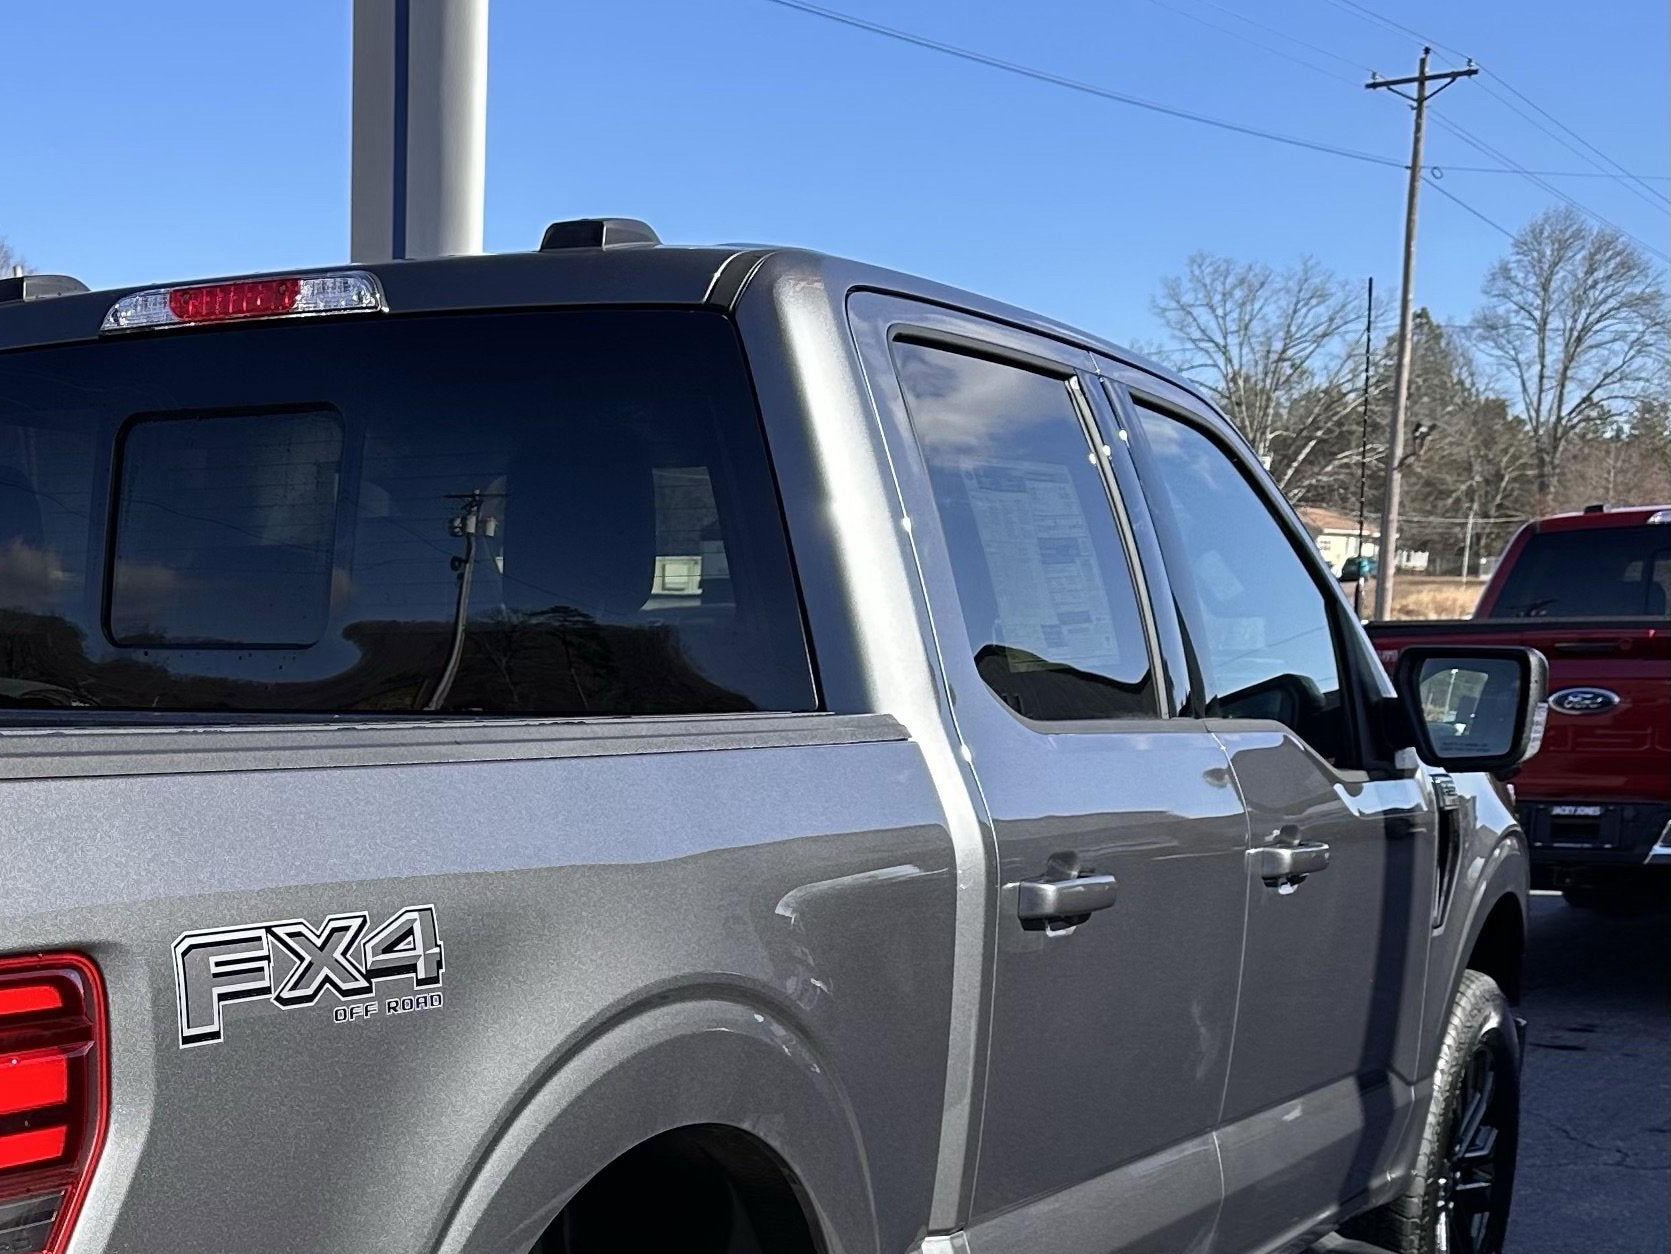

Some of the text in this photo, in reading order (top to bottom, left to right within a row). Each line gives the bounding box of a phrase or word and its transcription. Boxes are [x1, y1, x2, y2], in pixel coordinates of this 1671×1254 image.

[171, 904, 445, 1049] FX4
[333, 992, 444, 1023] OFF ROAD
